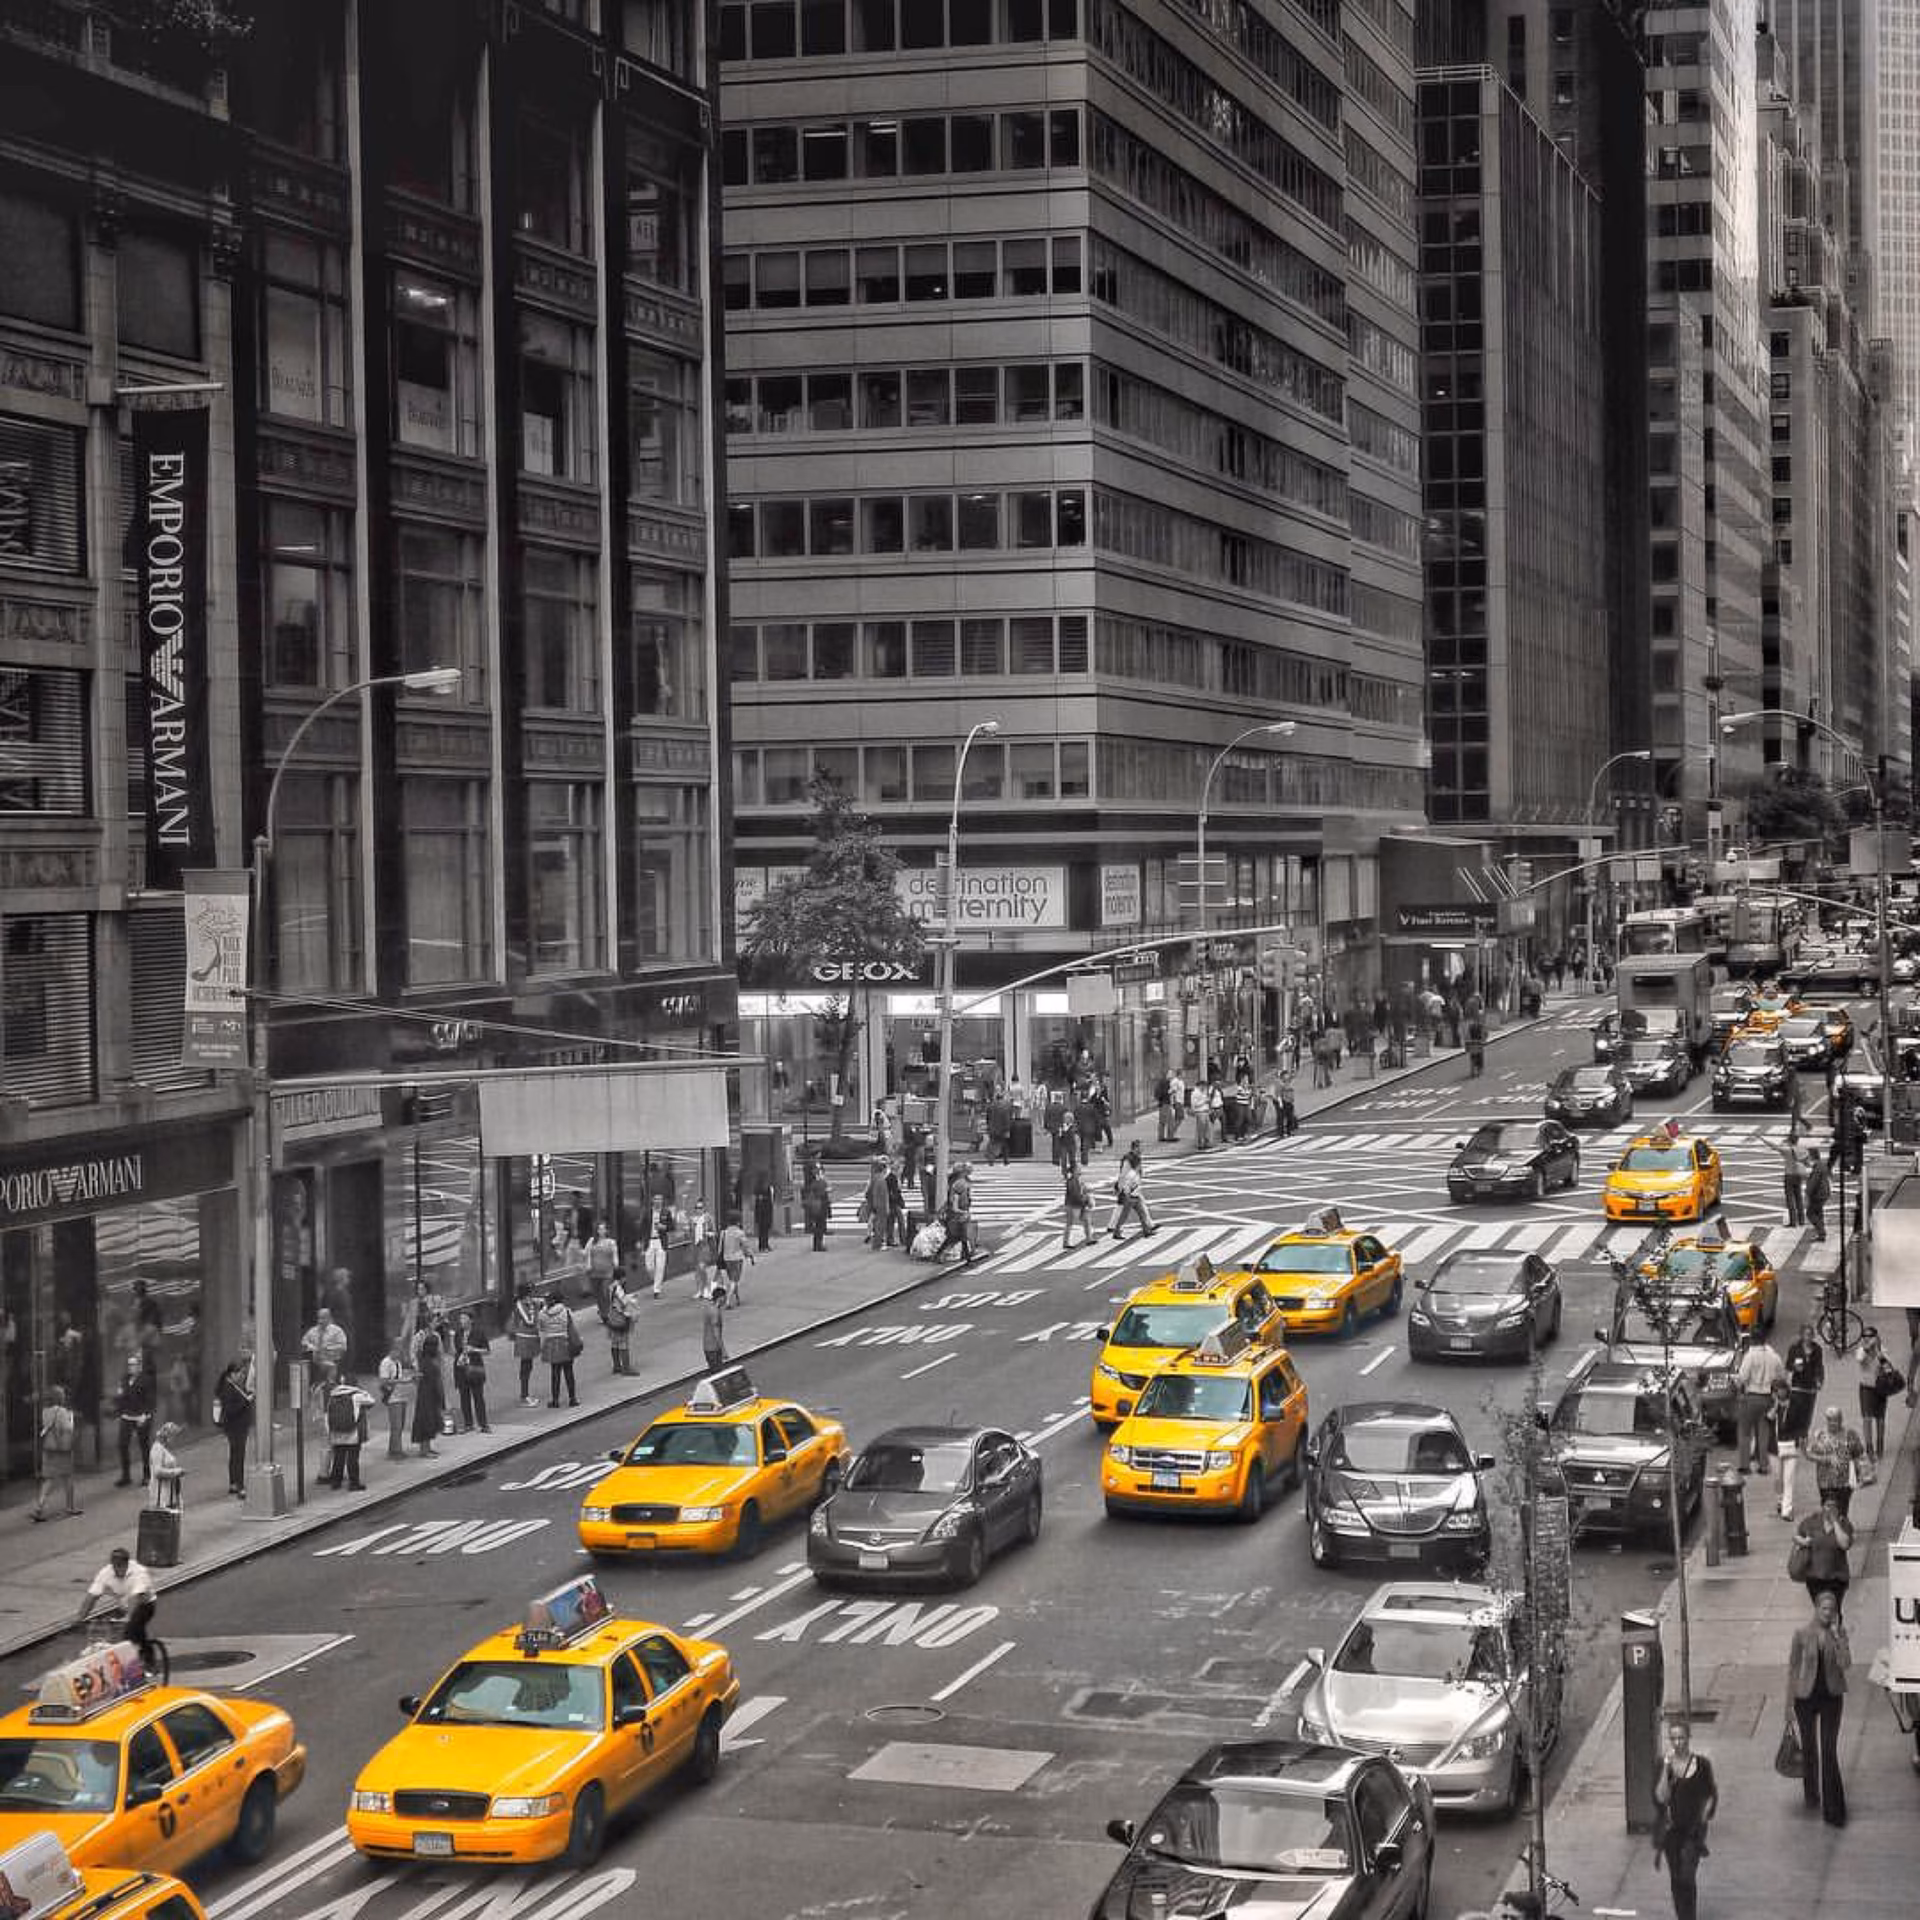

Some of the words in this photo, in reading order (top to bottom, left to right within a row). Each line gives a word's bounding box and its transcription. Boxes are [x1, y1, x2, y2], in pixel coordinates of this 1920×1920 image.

[148, 452, 184, 634] EMPORIO
[150, 691, 191, 849] ARMANI
[909, 871, 1049, 895] deination
[910, 894, 1049, 924] mternity
[812, 961, 921, 981] GEOX
[75, 1154, 143, 1200] ARMANI
[918, 1289, 1048, 1310] BUS
[812, 1324, 975, 1348] ONLY
[500, 1462, 620, 1491] US
[312, 1518, 551, 1557] ONLY
[752, 1599, 1000, 1649] ONLY
[1631, 1645, 1646, 1665] P
